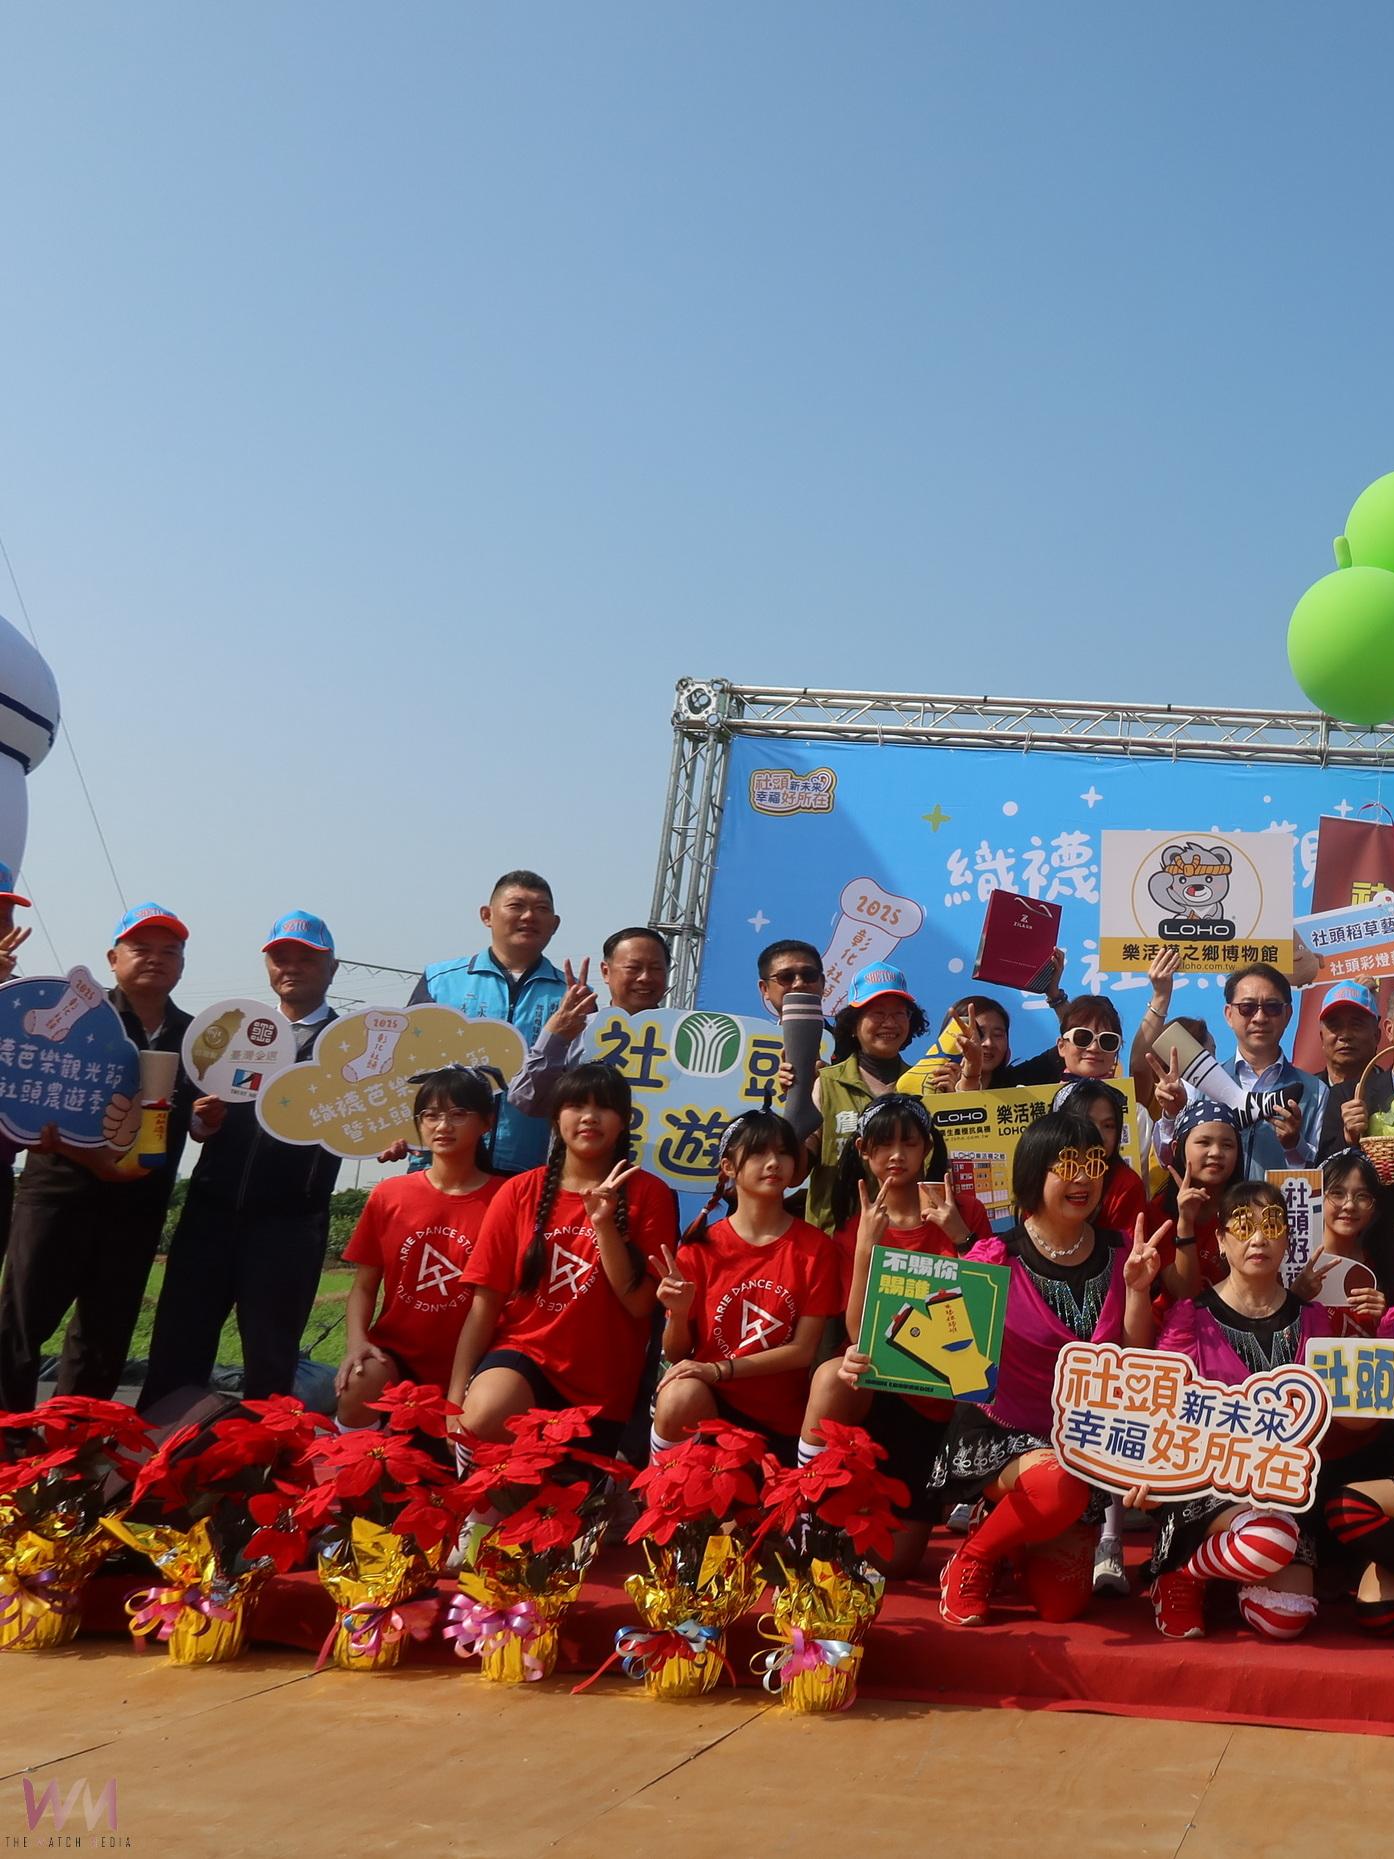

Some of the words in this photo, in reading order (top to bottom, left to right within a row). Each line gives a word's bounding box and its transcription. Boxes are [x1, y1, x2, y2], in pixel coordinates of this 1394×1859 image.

[755, 774, 822, 792] 社頭新未來
[756, 791, 829, 808] 幸福好所在
[856, 895, 902, 926] 2025
[1164, 925, 1230, 936] LOHO
[75, 979, 96, 1001] 2025
[373, 1018, 399, 1030] 2025
[936, 1111, 985, 1123] LOHO
[415, 1225, 458, 1240] DANCE
[544, 1225, 587, 1241] DANCE
[714, 1294, 733, 1323] ARIE
[731, 1279, 774, 1296] DANCE
[1065, 1355, 1290, 1442] 社頭新未來
[1064, 1409, 1304, 1493] 幸福好所在
